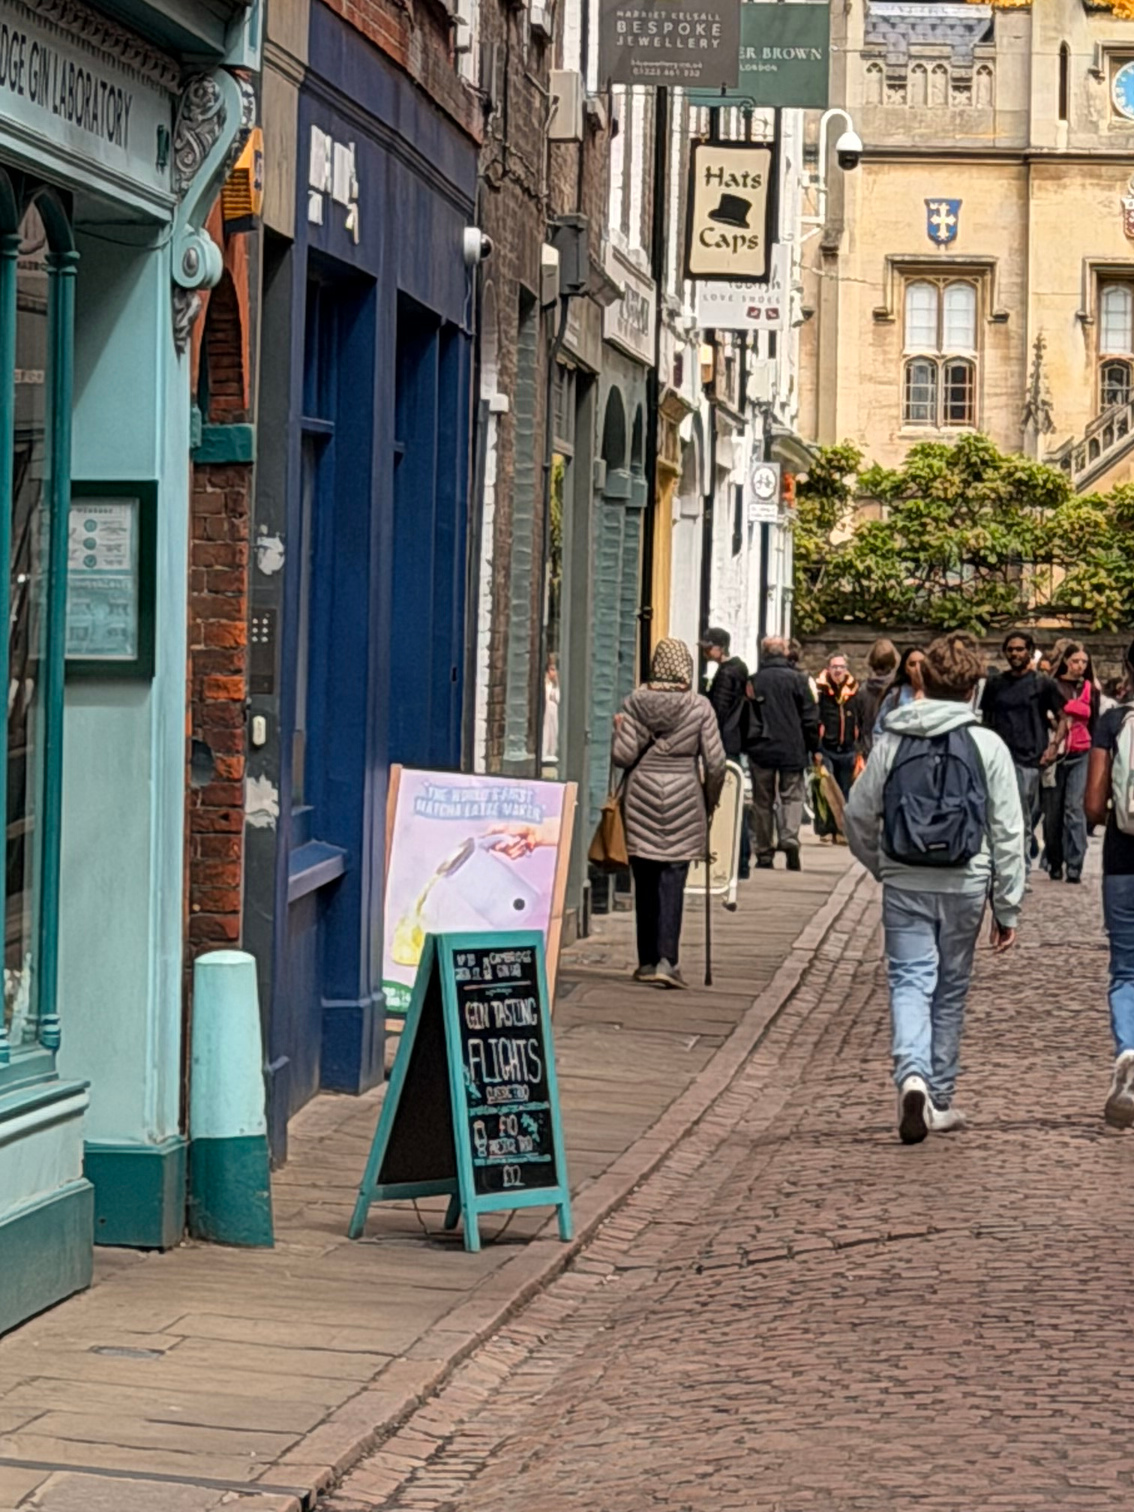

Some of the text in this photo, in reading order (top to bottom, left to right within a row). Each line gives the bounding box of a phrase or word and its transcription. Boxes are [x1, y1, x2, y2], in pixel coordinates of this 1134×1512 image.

[616, 20, 722, 36] BESPOKE
[616, 36, 720, 49] JEWELLERY
[762, 46, 822, 61] BROWN
[28, 41, 50, 110] GIN
[52, 52, 133, 152] LABORATORY
[704, 165, 762, 190] Hats
[699, 227, 759, 255] Caps
[703, 293, 734, 303] LOVE
[465, 997, 538, 1029] GIN TASTING
[467, 1037, 542, 1084] FLIGHTS
